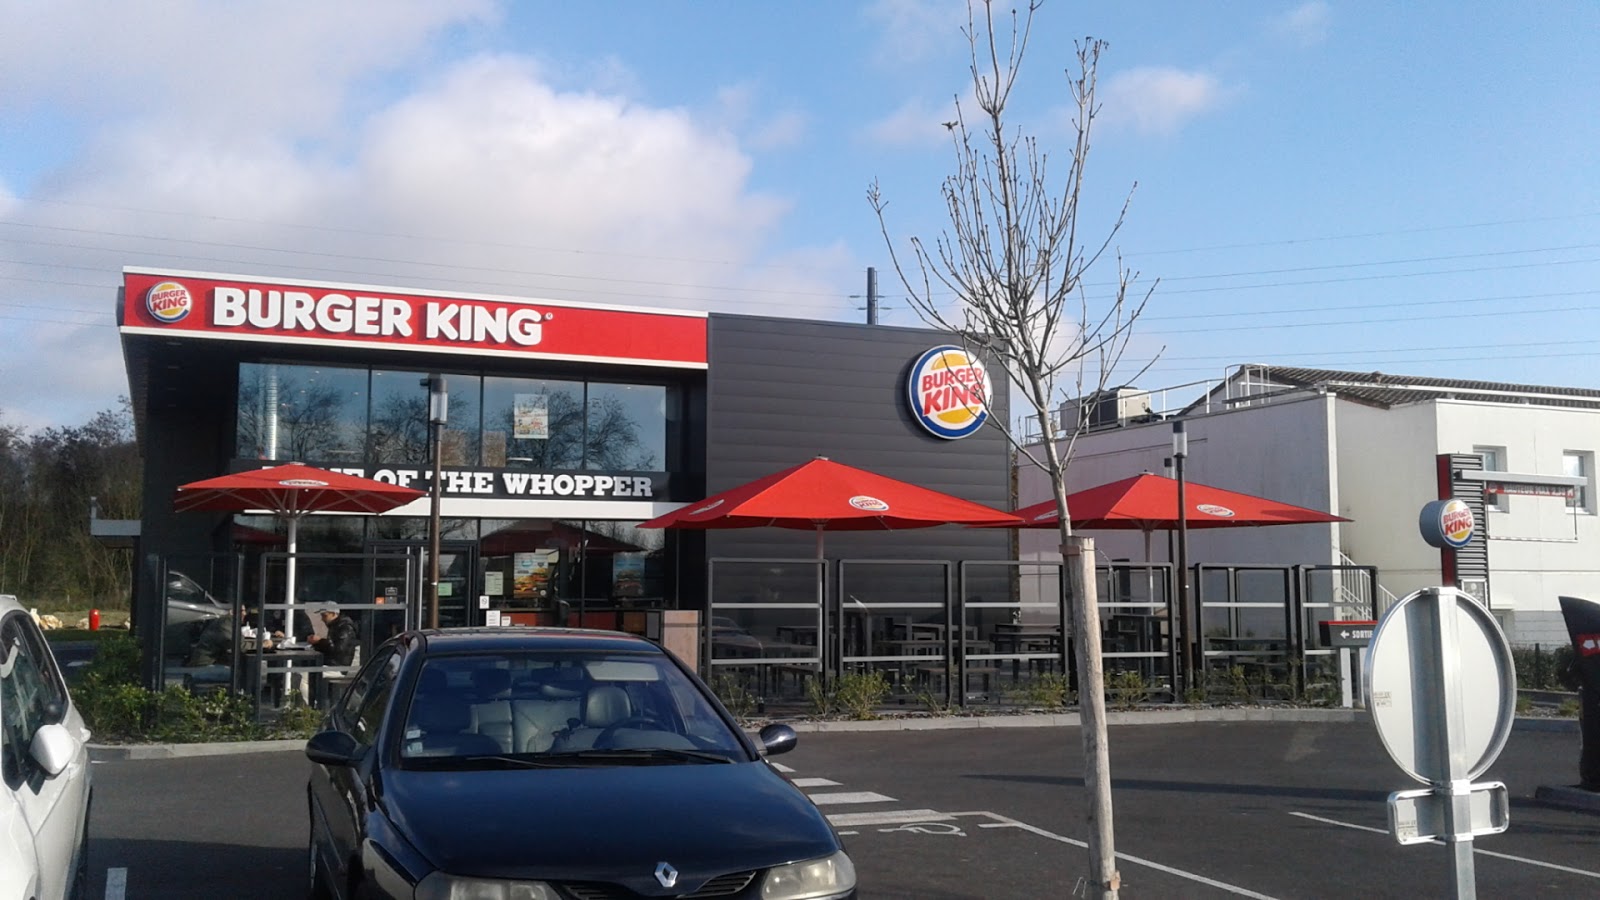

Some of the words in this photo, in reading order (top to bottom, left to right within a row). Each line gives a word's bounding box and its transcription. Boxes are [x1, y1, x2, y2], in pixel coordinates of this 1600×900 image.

[152, 289, 186, 301] BURGER
[152, 297, 187, 312] KING
[213, 287, 413, 337] BURGER
[426, 302, 542, 346] KING
[922, 367, 983, 393] BURGER
[923, 384, 985, 416] KING
[502, 472, 653, 497] WHOPPER
[1443, 508, 1470, 524] BURGER
[1445, 516, 1472, 535] KING
